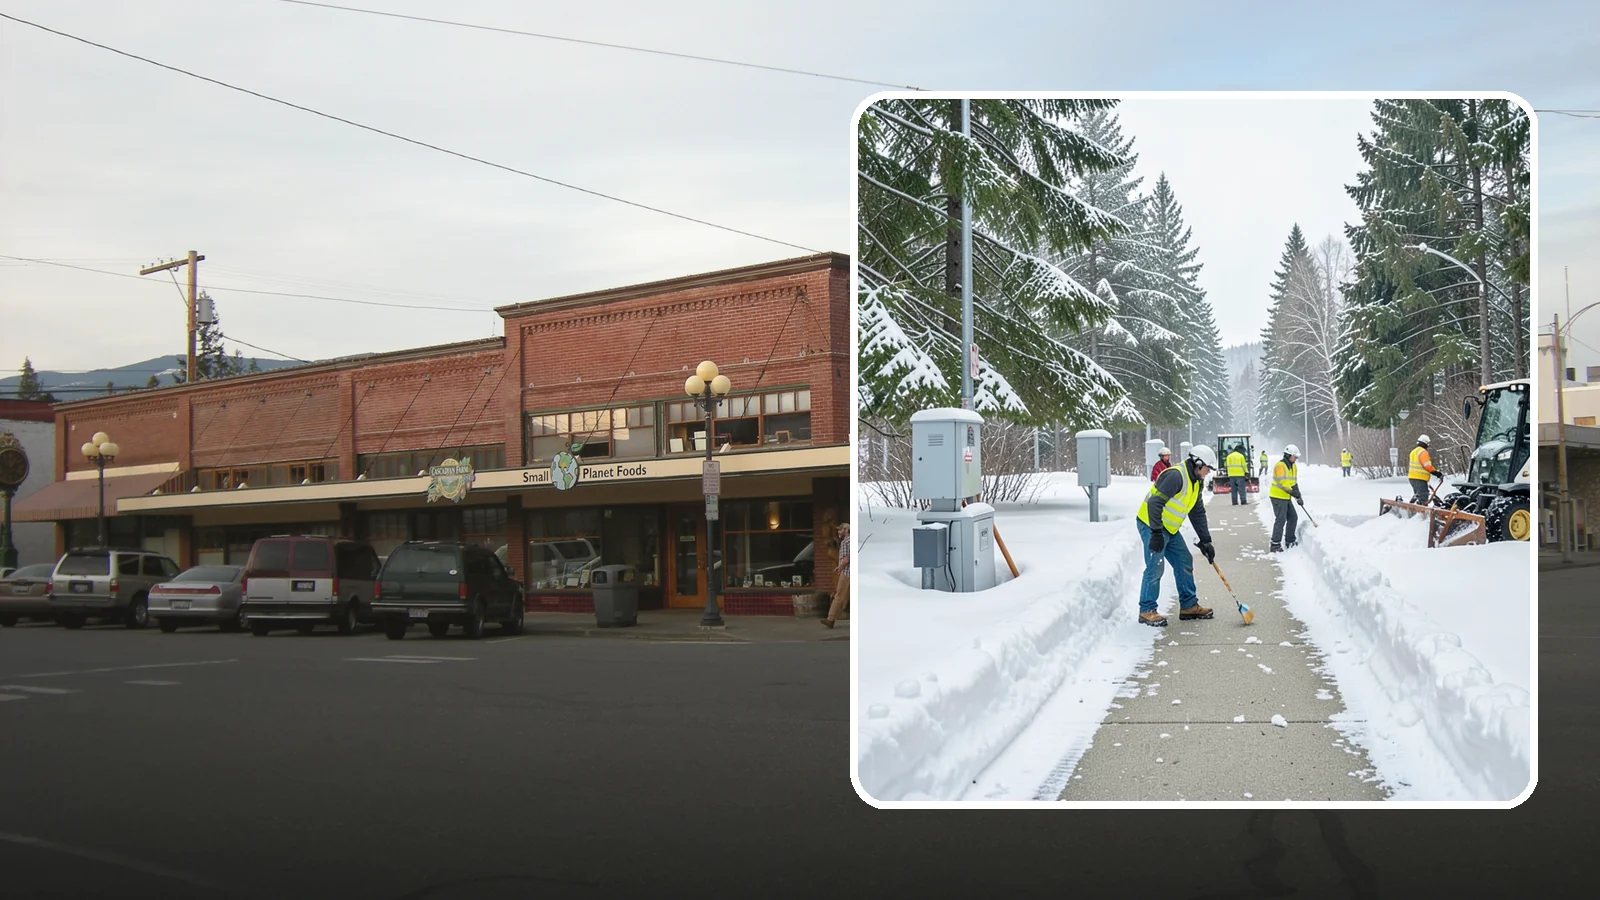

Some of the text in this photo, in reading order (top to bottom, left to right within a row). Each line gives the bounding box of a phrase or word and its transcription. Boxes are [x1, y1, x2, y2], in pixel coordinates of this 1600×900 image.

[523, 464, 647, 483] Small Planet Foods
